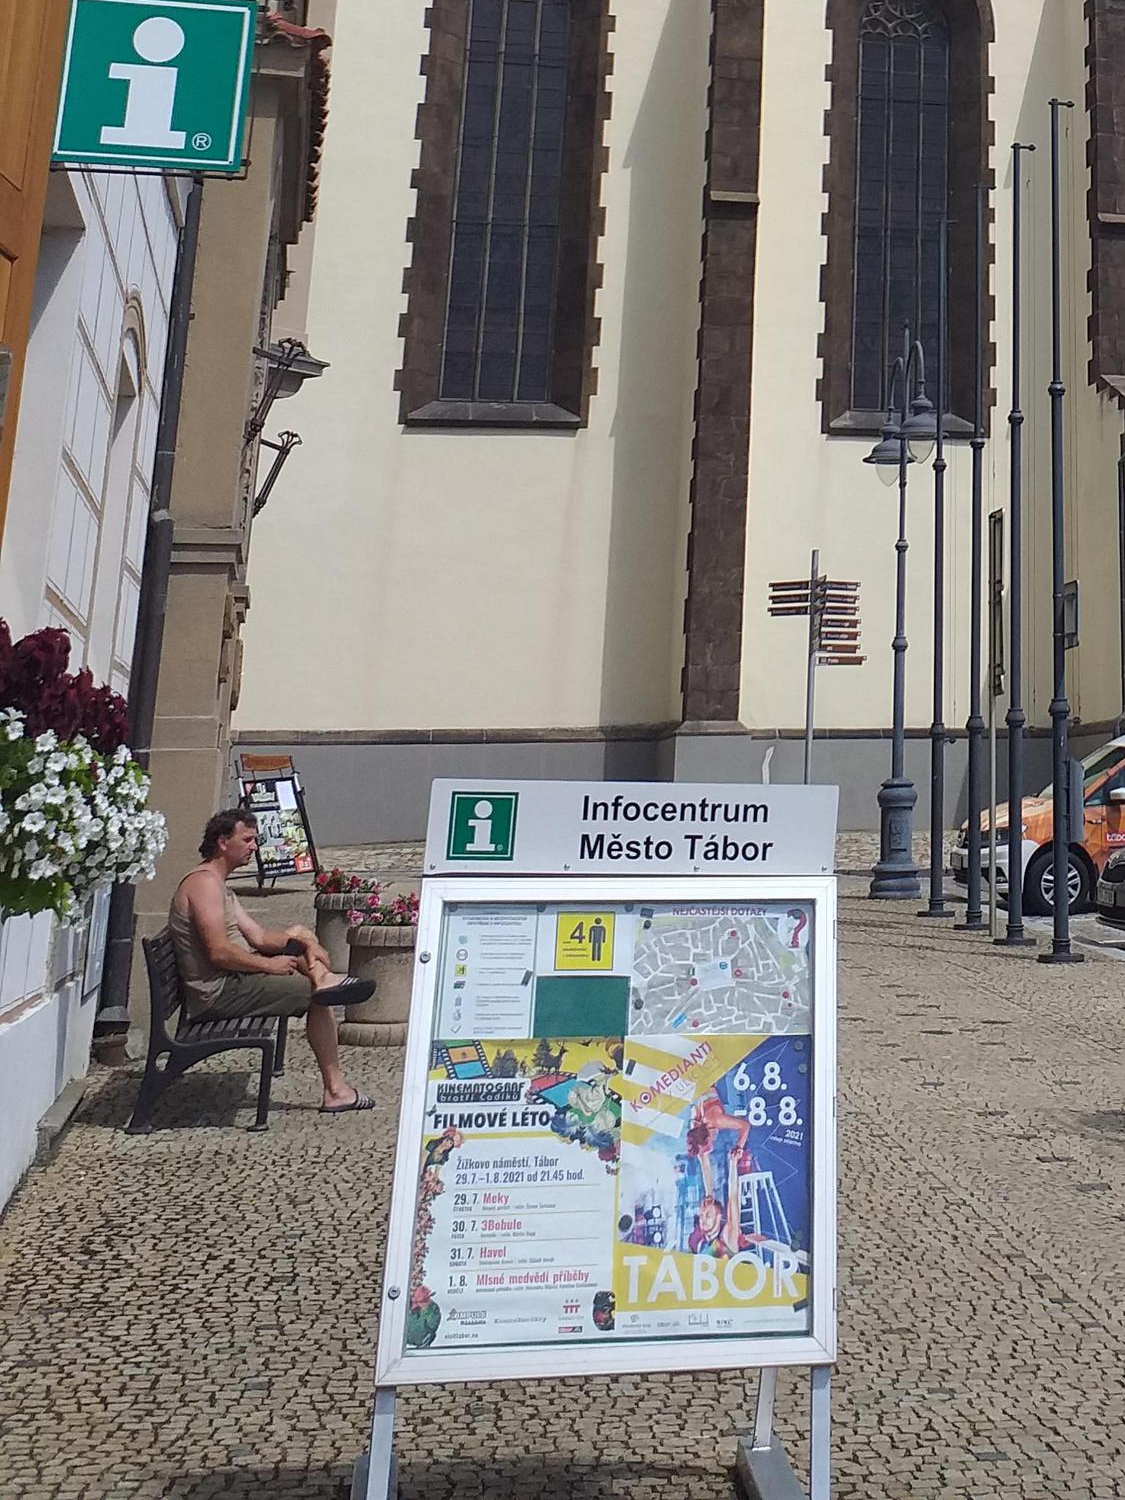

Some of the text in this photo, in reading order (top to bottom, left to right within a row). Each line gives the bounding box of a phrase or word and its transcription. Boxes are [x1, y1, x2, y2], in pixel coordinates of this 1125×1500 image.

[582, 795, 769, 823] Infocentrum
[579, 833, 774, 861] Město Tábor
[731, 907, 768, 916] DOTAZY
[570, 921, 586, 944] 4
[630, 1040, 713, 1112] KOMEDIANTI
[733, 1061, 787, 1091] 6. 8.
[437, 1082, 525, 1094] KINEMATOGRAF
[433, 1107, 551, 1129] FILMOVÉ LÉTO
[778, 1096, 803, 1126] 8.
[785, 1129, 803, 1140] 2021
[456, 1155, 559, 1170] Žižkovo náměstí, Tábor
[527, 1171, 538, 1182] od
[540, 1170, 564, 1182] 21.45
[566, 1168, 584, 1181] hod.
[454, 1193, 469, 1205] 29.
[482, 1192, 509, 1205] Meky
[452, 1218, 522, 1232] 30. 7. 3Bobule
[450, 1246, 507, 1260] 31. 7. Havel
[449, 1269, 590, 1287] 1. 8. Mlsné medvědí příběhy
[622, 1239, 799, 1304] TÁBOR
